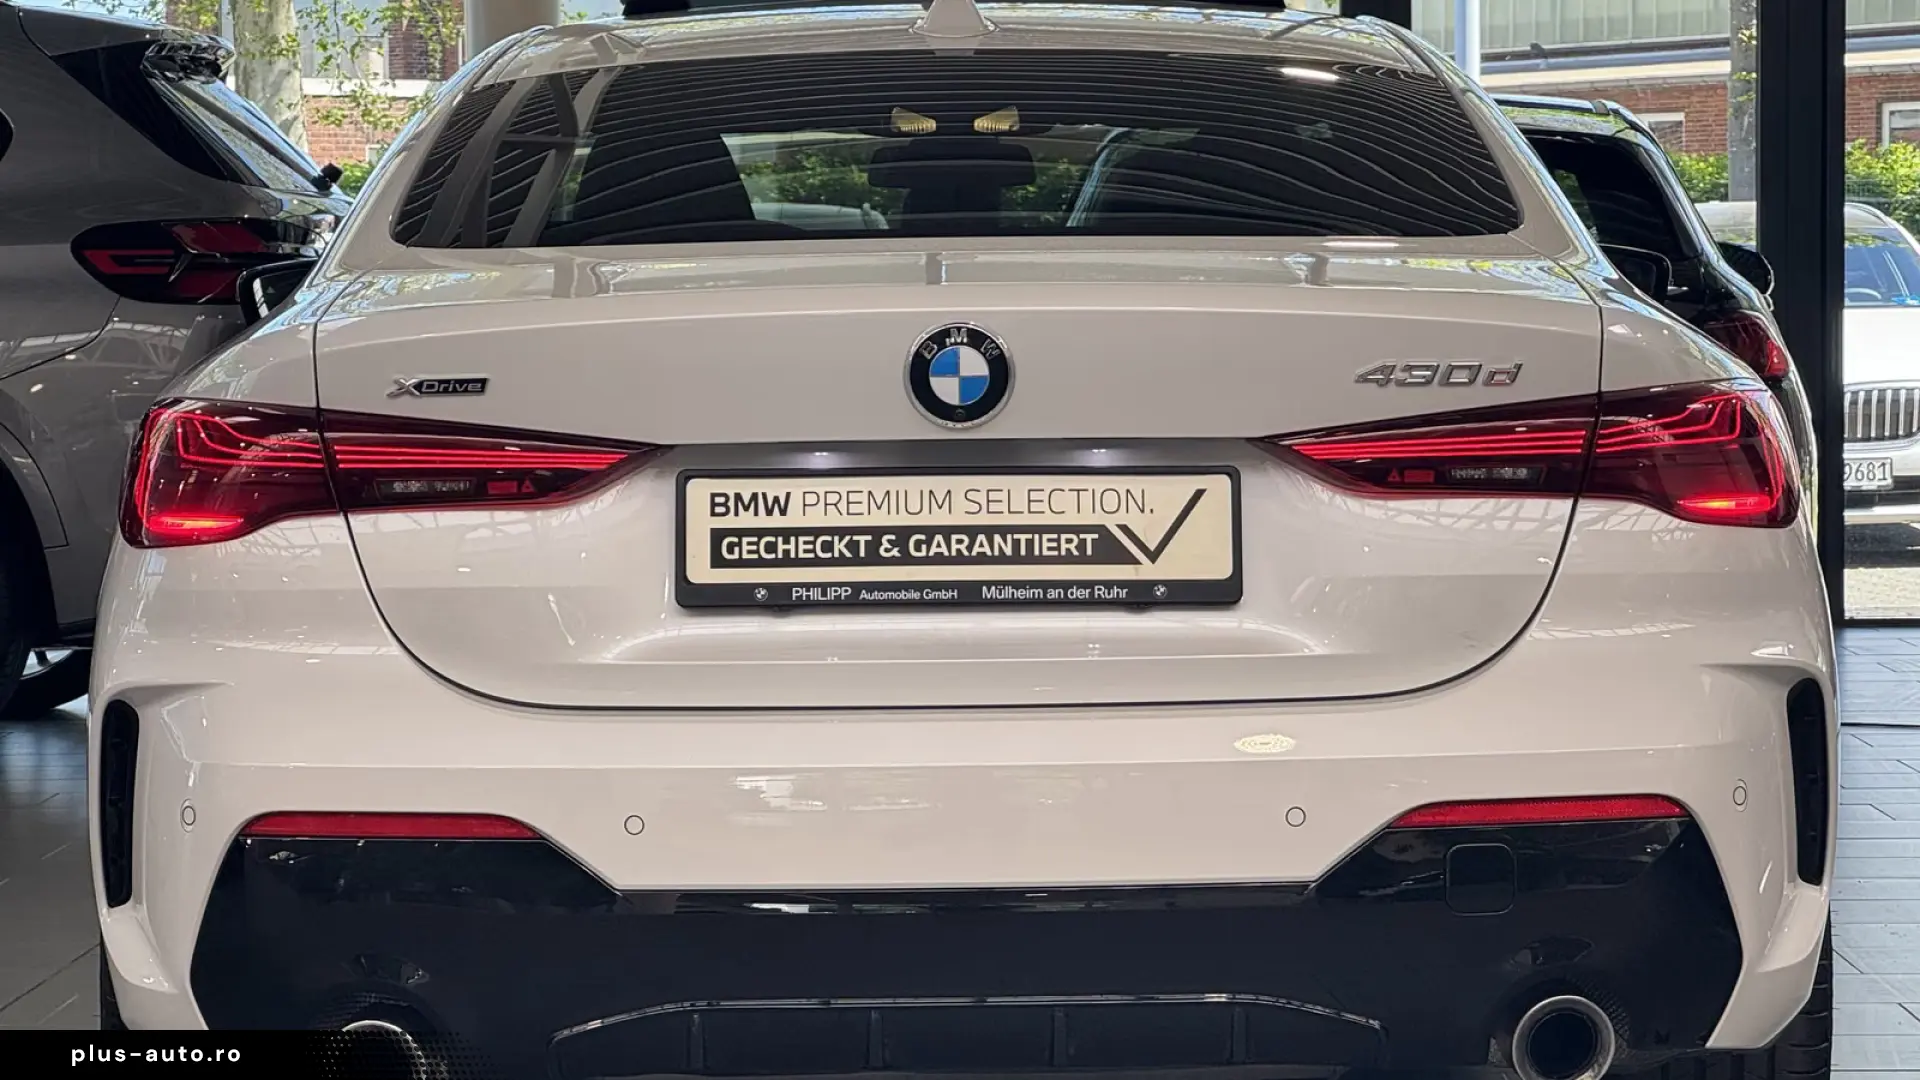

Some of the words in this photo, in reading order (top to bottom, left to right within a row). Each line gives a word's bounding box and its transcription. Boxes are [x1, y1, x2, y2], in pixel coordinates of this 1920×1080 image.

[919, 328, 1001, 360] BMW
[1354, 359, 1524, 387] 430d
[709, 491, 791, 517] BMW
[802, 489, 952, 516] PREMIUM
[964, 487, 1154, 515] SELECTION.
[721, 534, 872, 559] GECHECKT
[878, 534, 901, 557] &
[908, 533, 1099, 557] GARANTIERT
[792, 587, 852, 601] PHILIPP
[858, 589, 921, 600] Automobile
[922, 588, 959, 600] GmbH
[982, 585, 1043, 600] Mülheim
[1046, 587, 1065, 599] an
[1067, 585, 1091, 599] der
[1094, 585, 1129, 599] Ruhr
